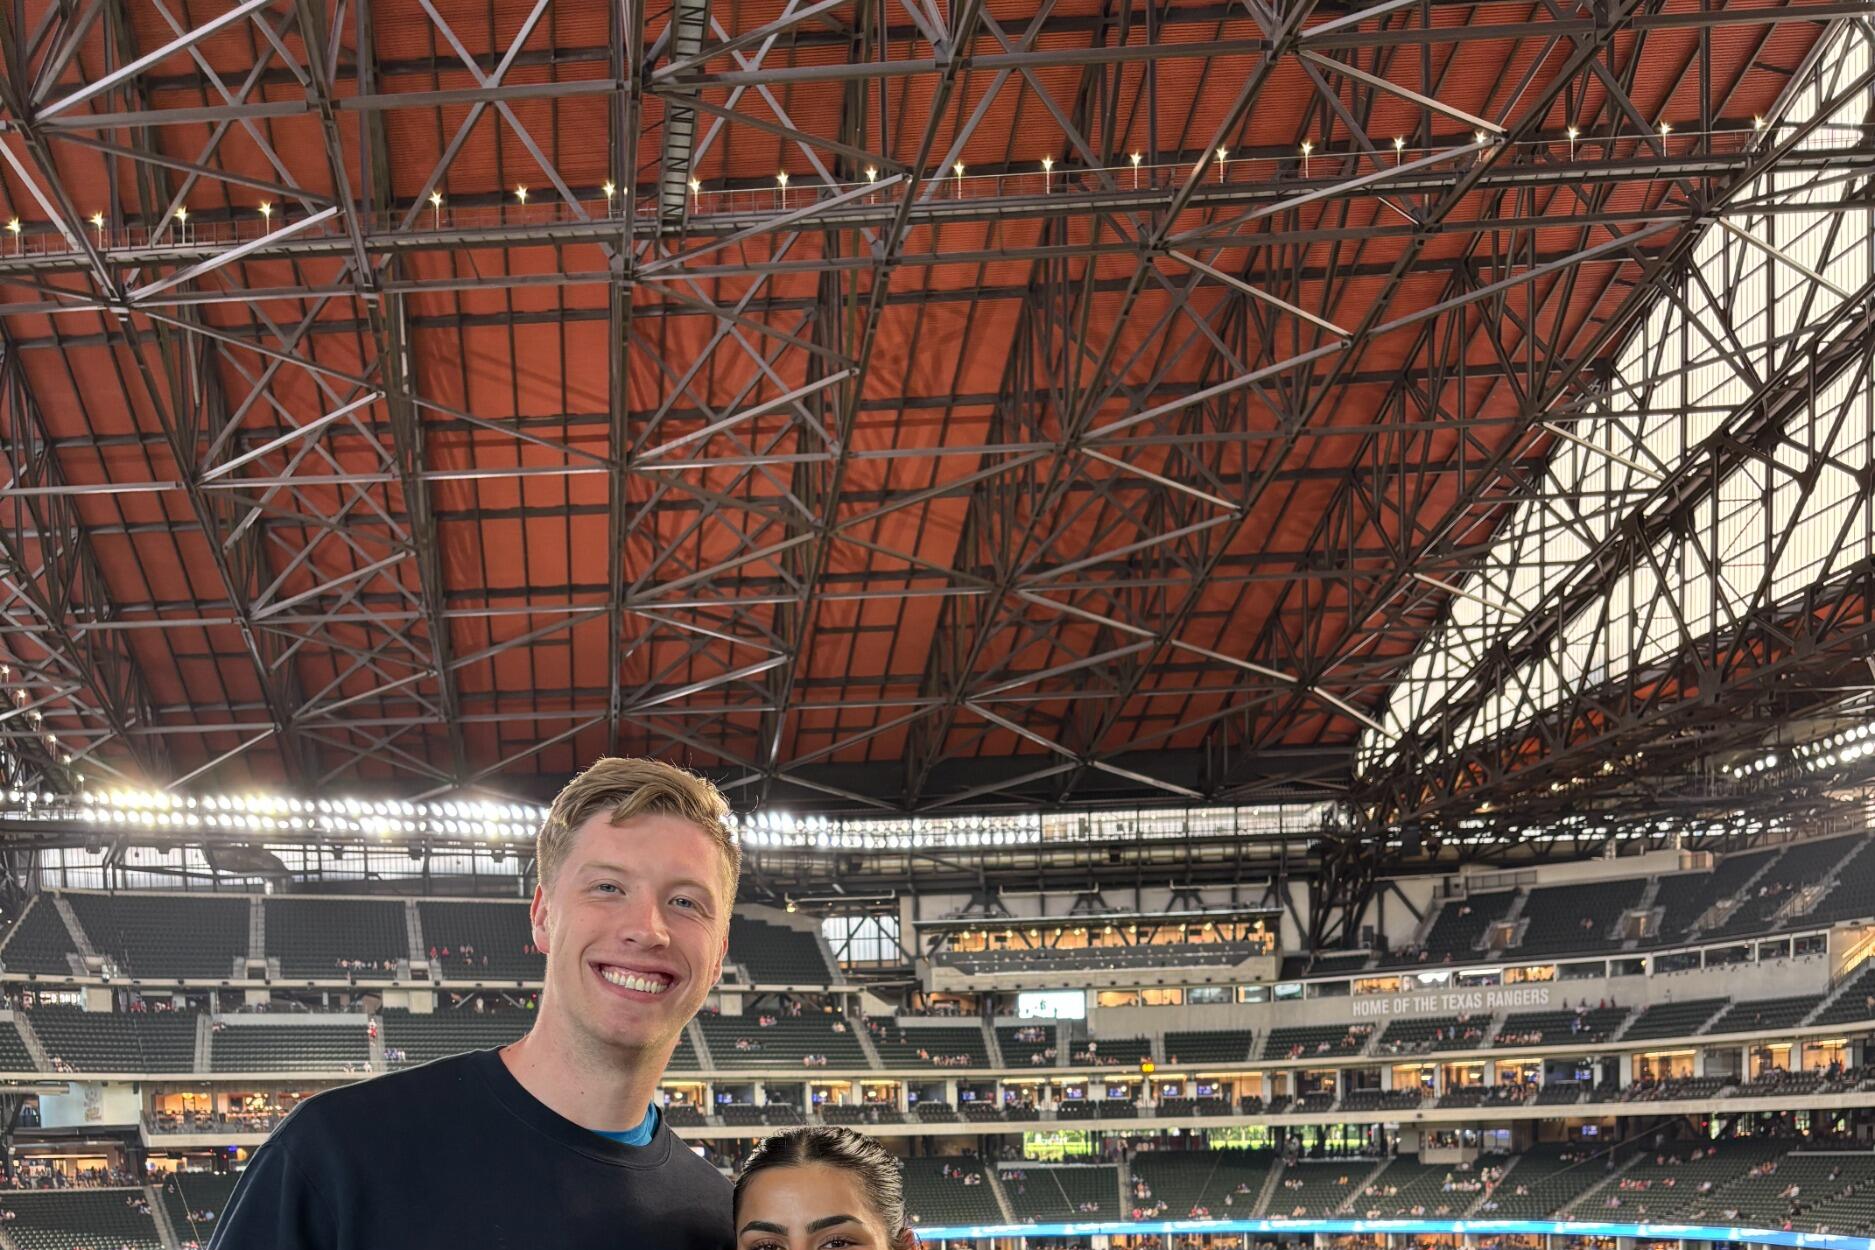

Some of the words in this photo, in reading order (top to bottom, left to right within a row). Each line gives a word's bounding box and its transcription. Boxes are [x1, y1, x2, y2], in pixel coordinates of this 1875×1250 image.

[1352, 1001, 1389, 1016] HOME
[1393, 999, 1409, 1013] OF
[1414, 997, 1437, 1012] THE
[1441, 993, 1482, 1010] TEXAS
[1486, 989, 1549, 1007] RANGERS
